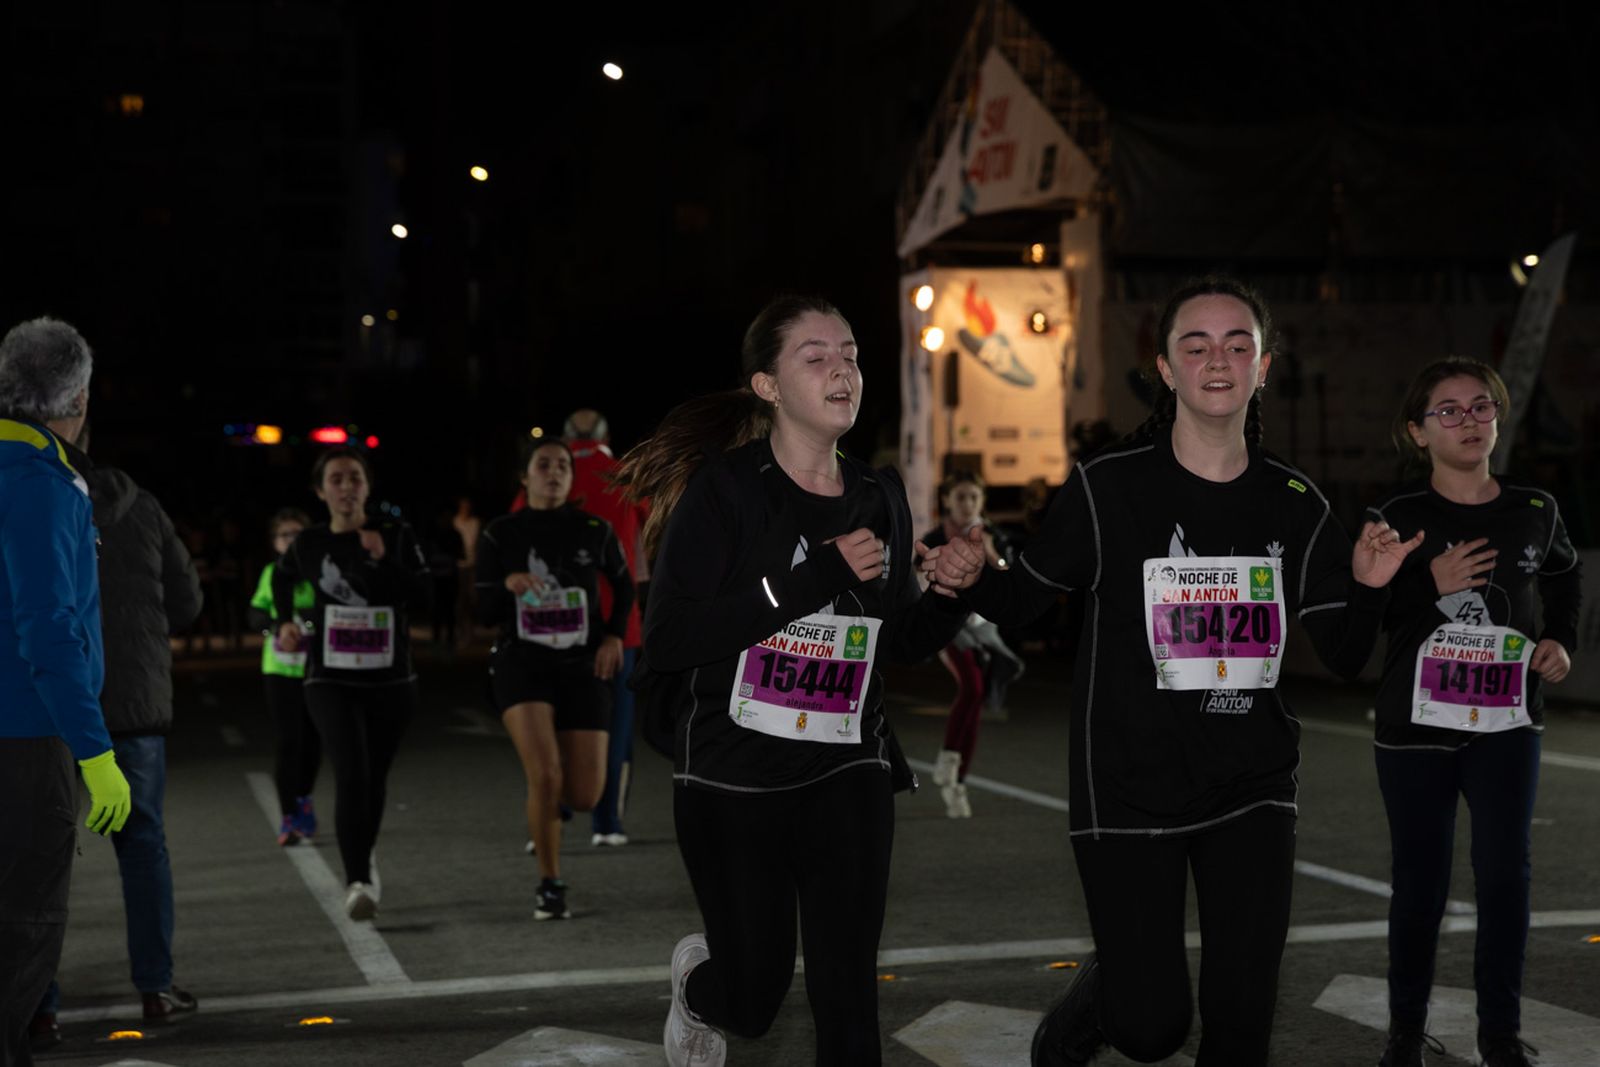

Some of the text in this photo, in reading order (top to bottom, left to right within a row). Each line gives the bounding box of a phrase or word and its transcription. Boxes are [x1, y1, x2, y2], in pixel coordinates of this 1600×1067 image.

[1178, 572, 1238, 585] NOCHE DE
[1162, 585, 1239, 603] SAN ANTÓN
[1456, 601, 1484, 626] 43
[1167, 604, 1271, 644] 15420
[780, 624, 837, 642] NOCHE DE
[1446, 635, 1496, 648] NOCHE DE
[790, 641, 834, 658] ANTÓN
[1432, 646, 1456, 658] SAN
[1457, 647, 1496, 662] ANTÓN
[760, 652, 856, 700] 15444
[1437, 661, 1513, 696] 14197
[1210, 688, 1238, 696] SAN
[785, 698, 824, 711] alejandra
[1207, 693, 1254, 709] ANTÓN
